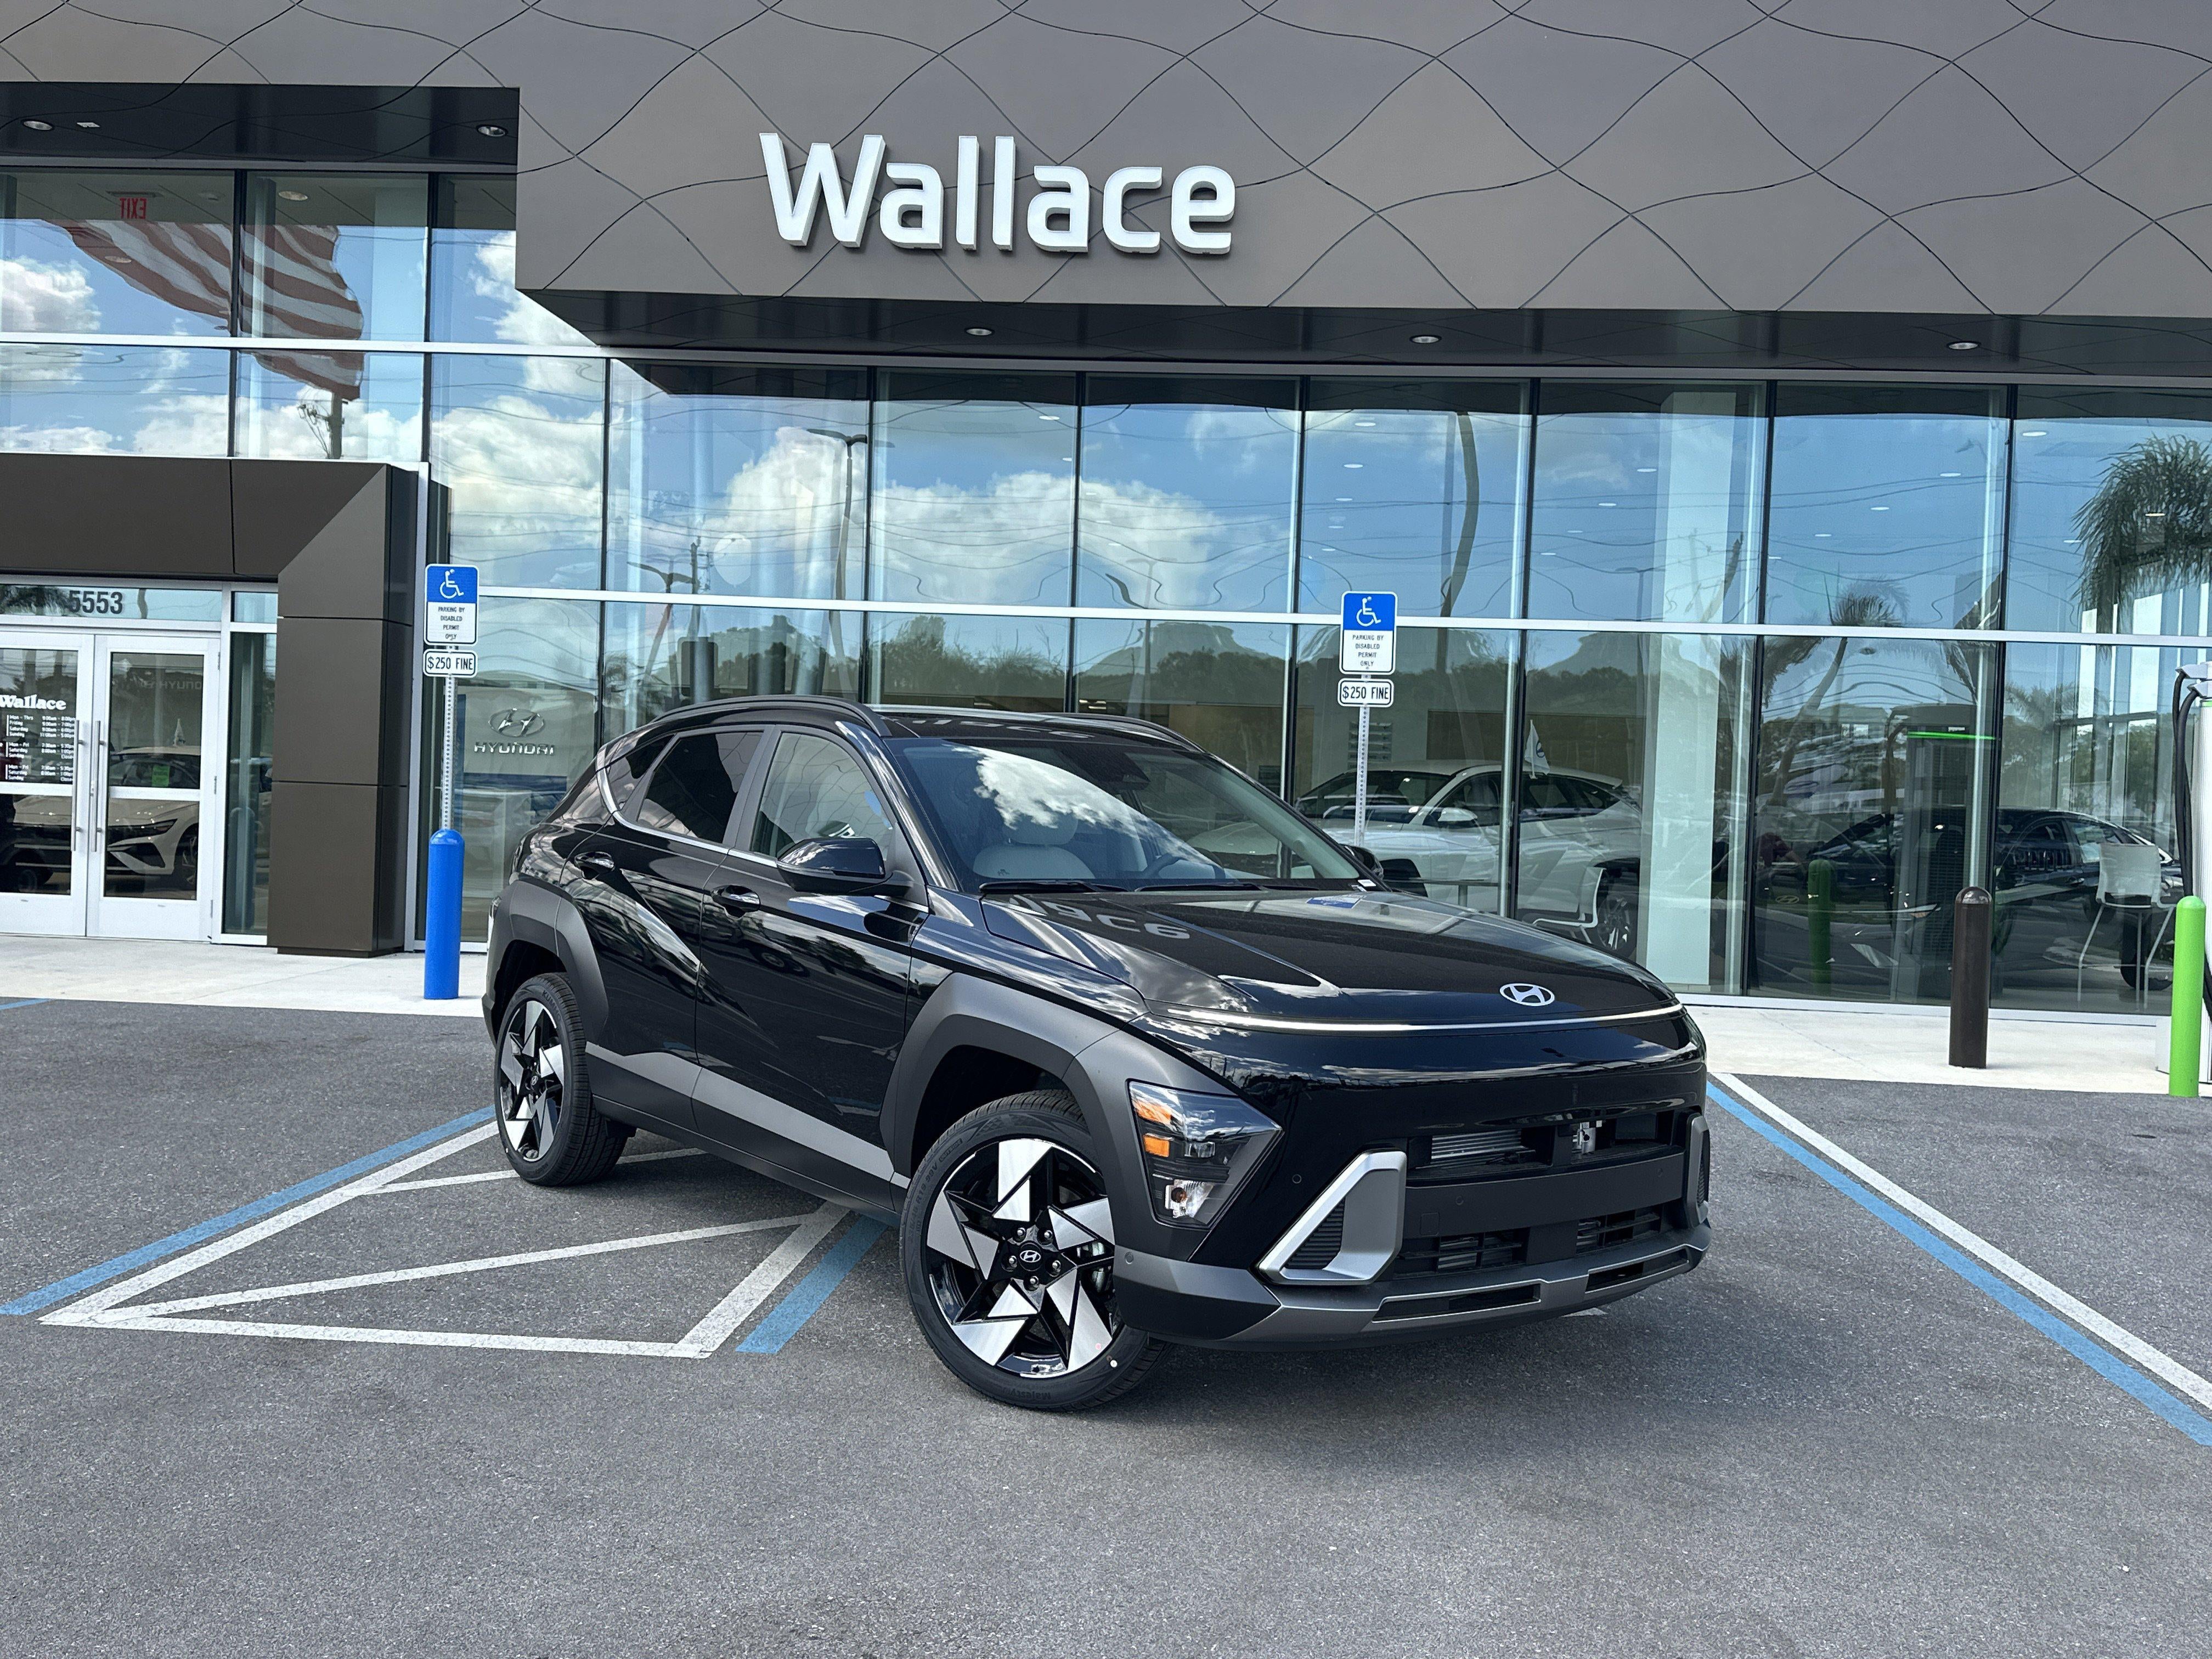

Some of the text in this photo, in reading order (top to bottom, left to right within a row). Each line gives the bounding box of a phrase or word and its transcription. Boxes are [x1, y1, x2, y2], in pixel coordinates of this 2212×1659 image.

[759, 133, 1235, 255] Wallace
[69, 590, 122, 614] 5553
[427, 656, 473, 670] $250 FINE
[1342, 686, 1389, 699] $250 FINE
[0, 694, 66, 710] Wallace
[473, 742, 554, 755] HYUNDAI
